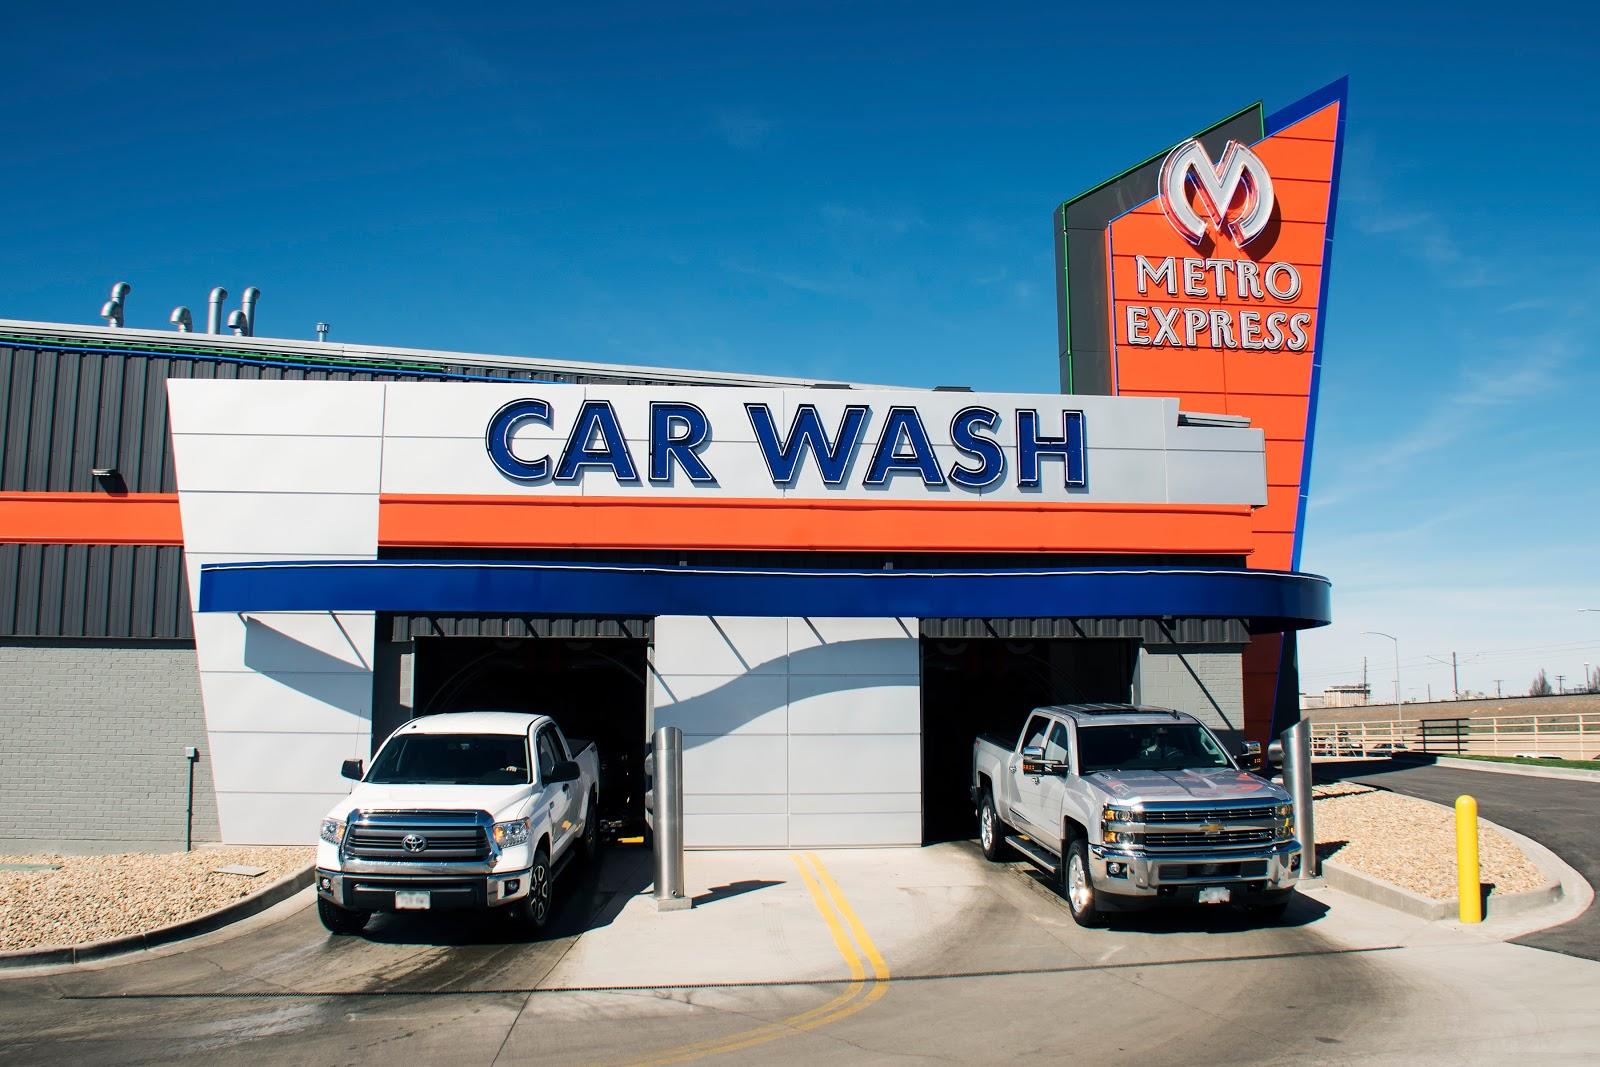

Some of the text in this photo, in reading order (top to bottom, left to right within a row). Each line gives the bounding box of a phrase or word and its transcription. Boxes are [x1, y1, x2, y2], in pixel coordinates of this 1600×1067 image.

[1135, 255, 1301, 300] METRO
[1126, 306, 1311, 350] EXPRESS
[485, 397, 1088, 488] CAR WASH
